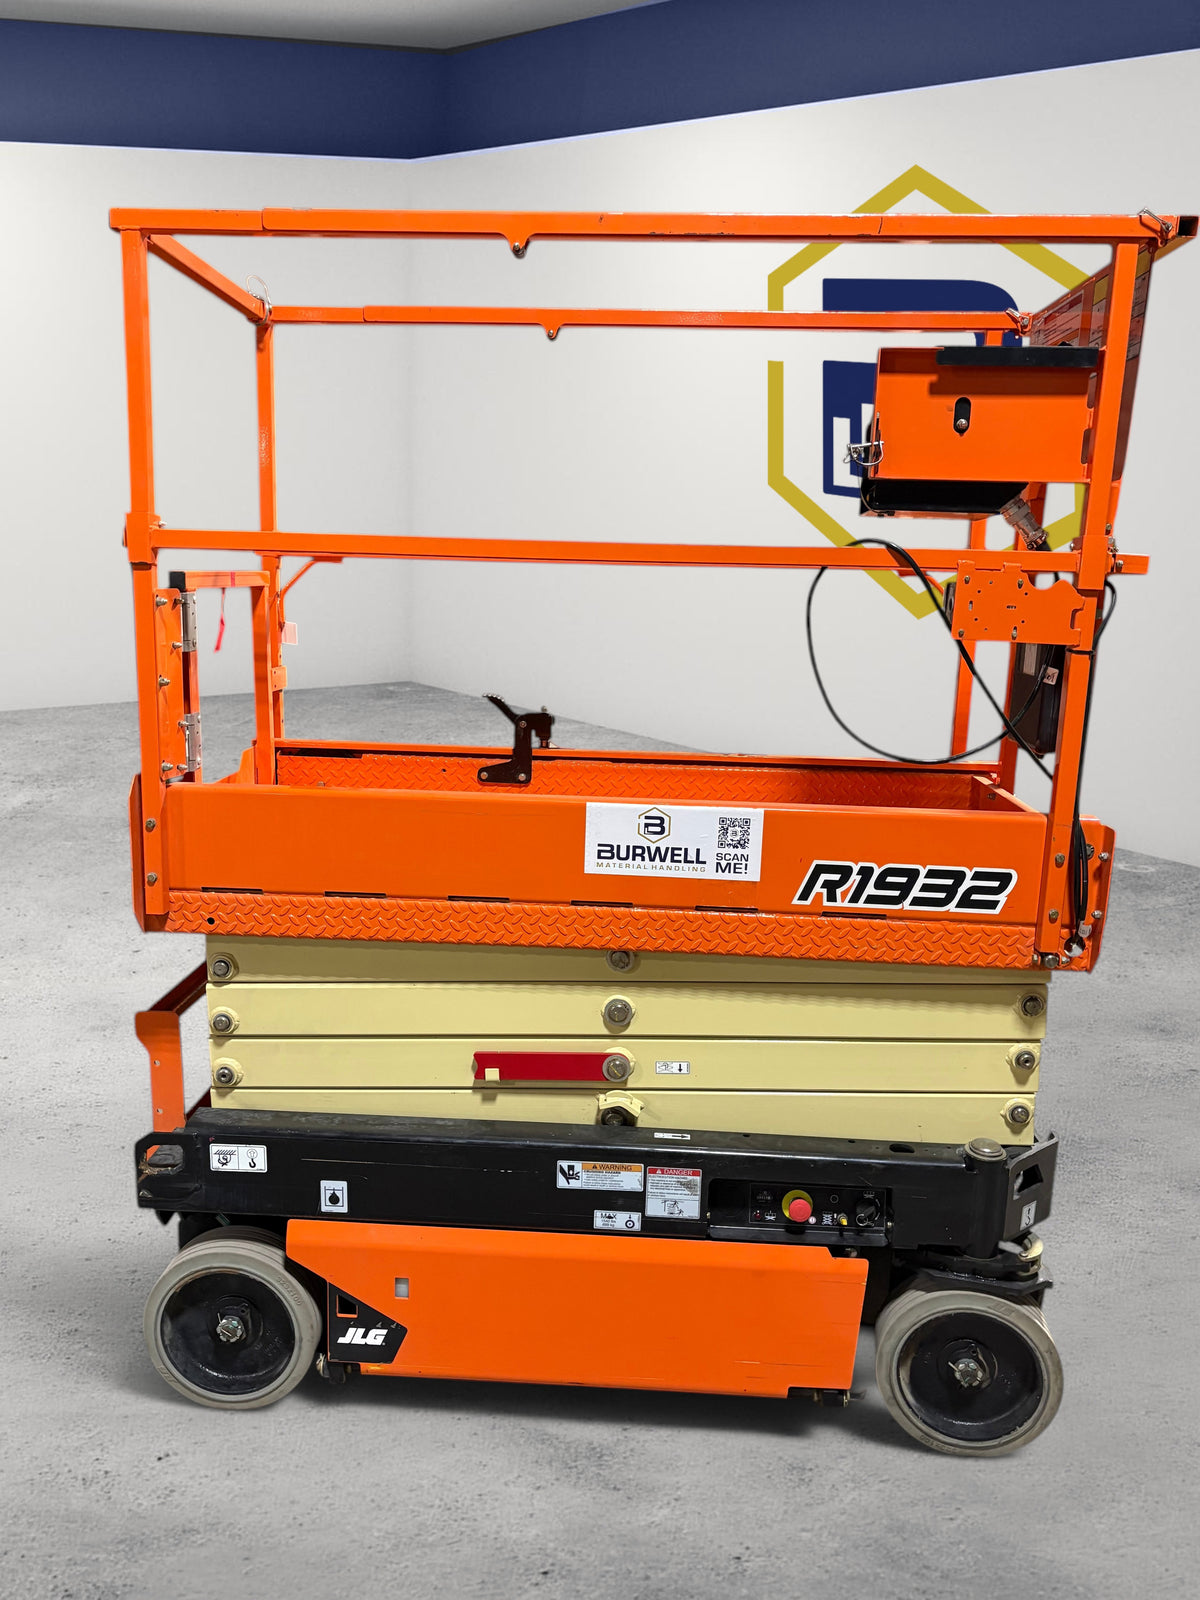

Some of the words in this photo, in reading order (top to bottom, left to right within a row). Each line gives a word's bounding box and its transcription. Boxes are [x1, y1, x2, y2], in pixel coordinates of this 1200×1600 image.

[597, 843, 707, 865] BURWELL
[715, 852, 749, 863] SCAN
[596, 861, 648, 871] MATERIAL
[651, 864, 706, 873] HANDLING
[715, 862, 748, 875] ME!
[794, 862, 1015, 912] R1932
[599, 1163, 633, 1172] WARNING
[663, 1168, 693, 1176] DANGER
[600, 1212, 617, 1220] MAX
[336, 1327, 389, 1346] JLG
